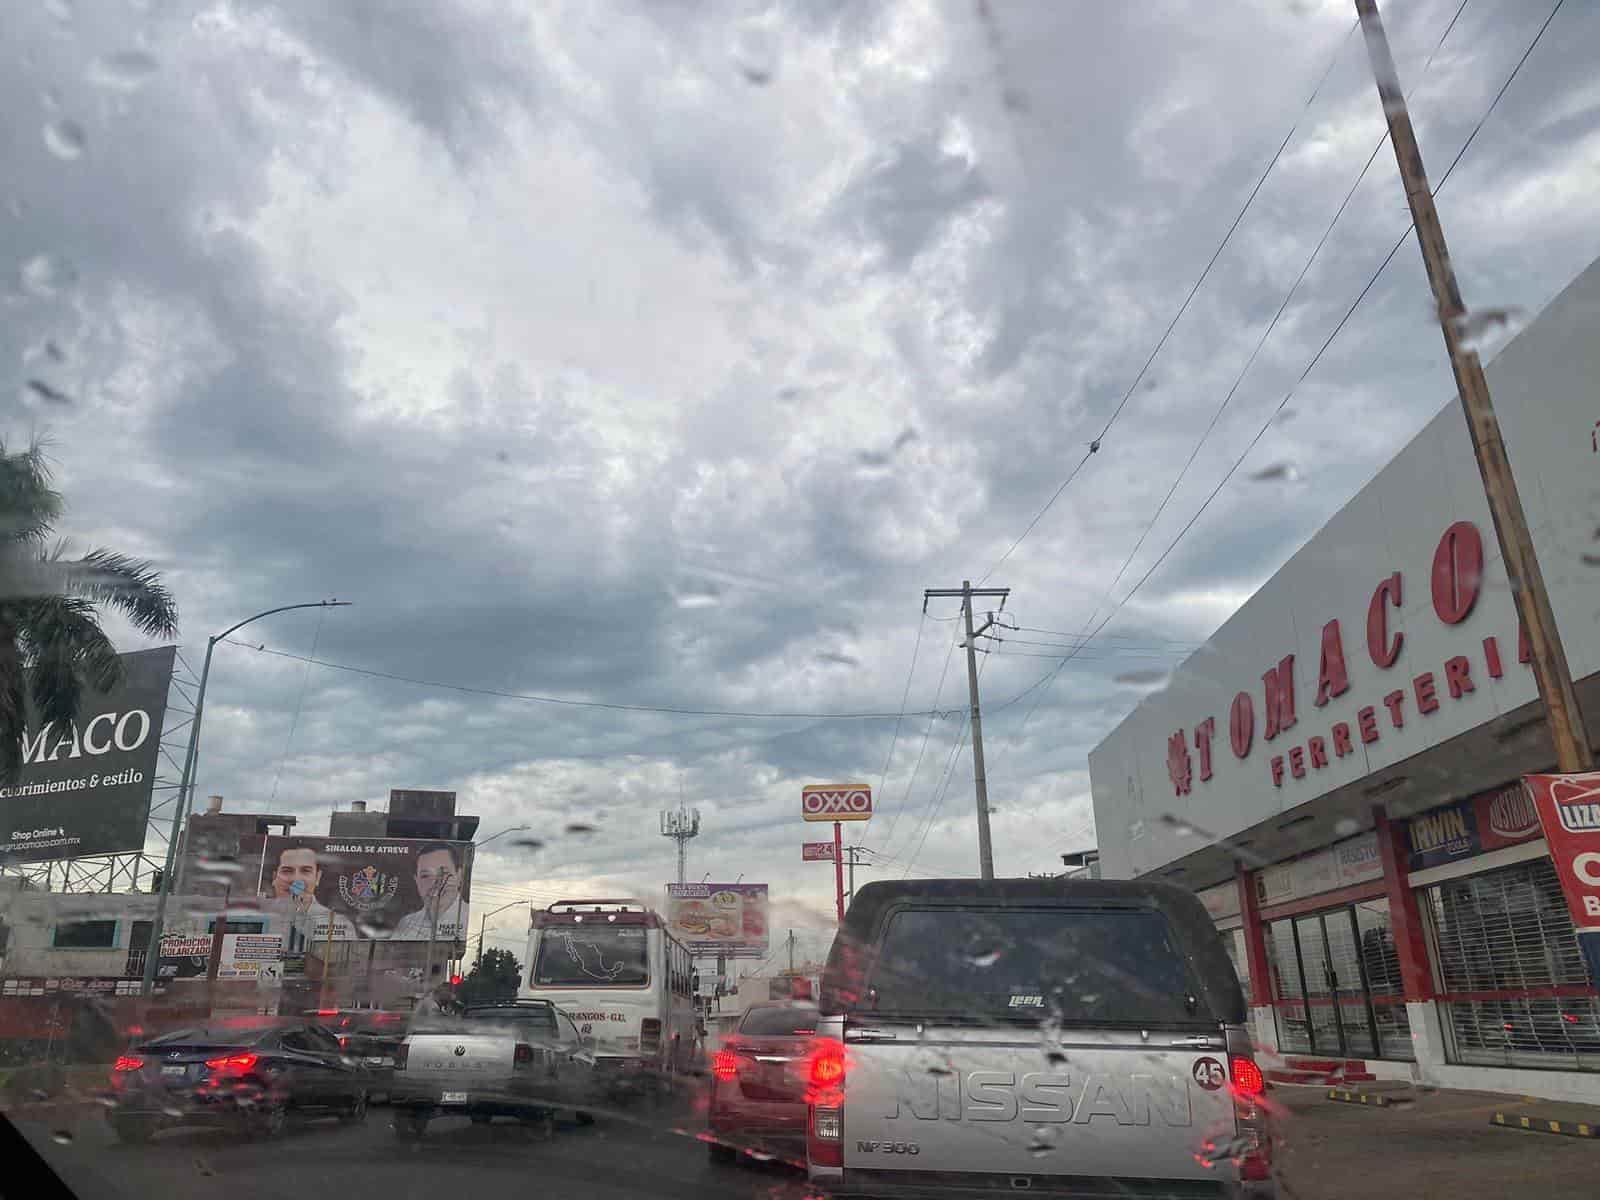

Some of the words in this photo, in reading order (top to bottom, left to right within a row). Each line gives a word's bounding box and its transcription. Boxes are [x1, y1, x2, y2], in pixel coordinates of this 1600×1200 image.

[1194, 520, 1484, 783] TOMACO
[89, 774, 98, 788] &
[103, 768, 143, 786] estilo
[804, 792, 868, 813] OXXO
[11, 831, 32, 841] Shop
[32, 828, 57, 839] Online
[325, 844, 363, 853] SINALOA
[364, 845, 374, 853] SE
[377, 845, 409, 854] ATREVE
[1195, 1062, 1223, 1085] 45
[886, 1070, 1192, 1128] NISSAN
